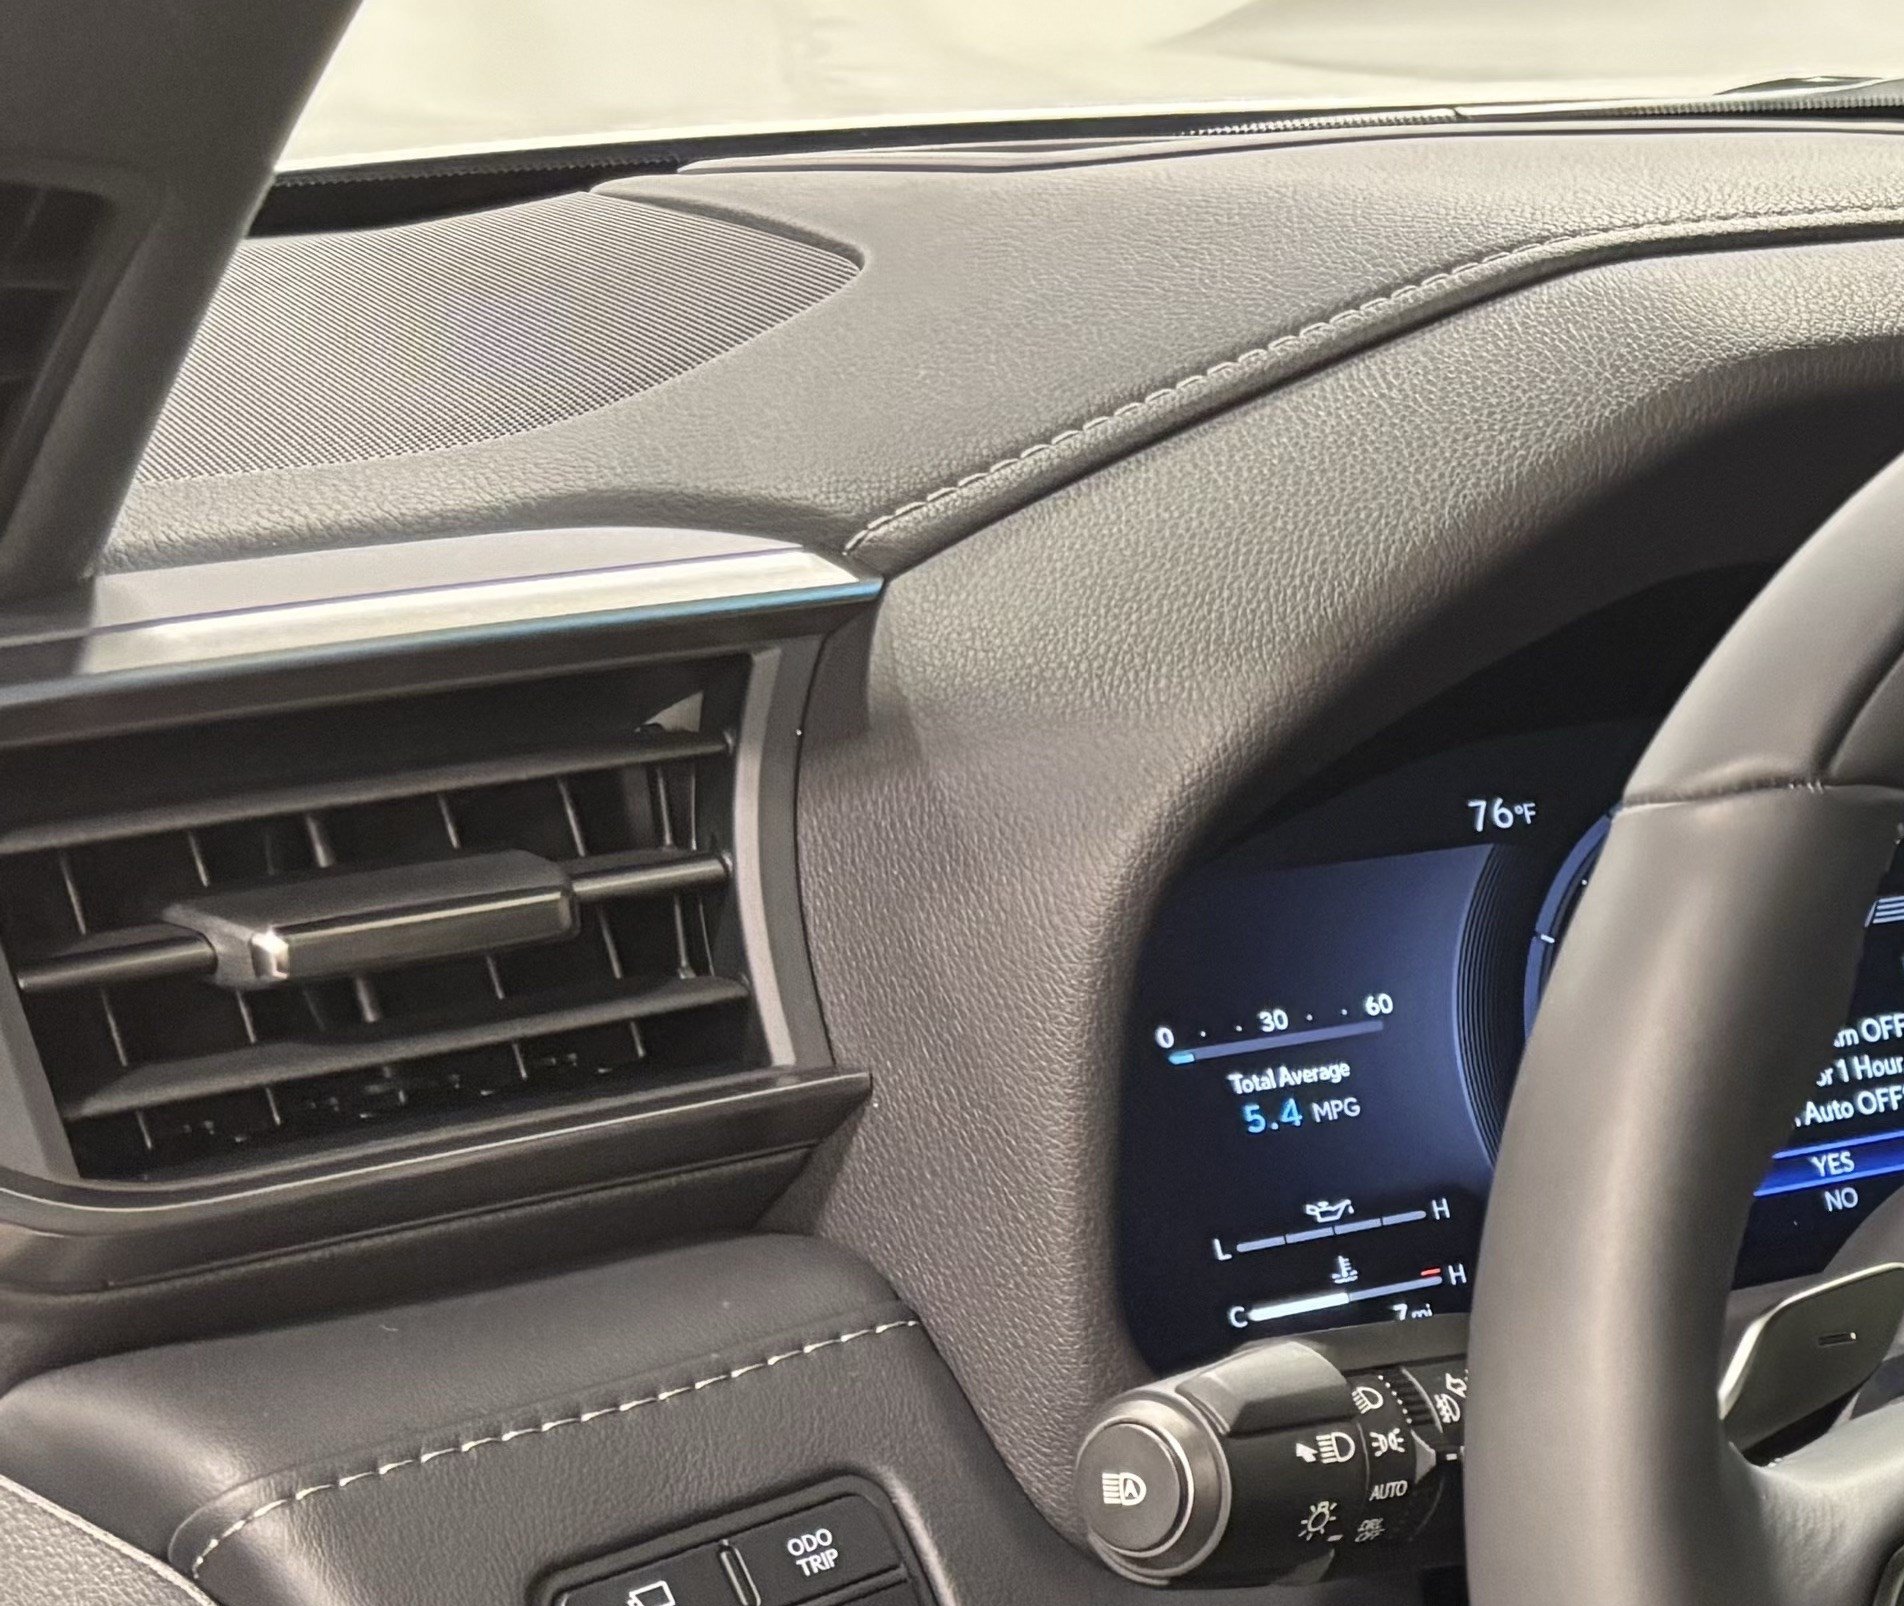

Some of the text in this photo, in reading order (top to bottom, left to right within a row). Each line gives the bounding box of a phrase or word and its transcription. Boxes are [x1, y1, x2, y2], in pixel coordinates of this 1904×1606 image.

[1364, 993, 1394, 1016] 60
[1259, 1008, 1290, 1034] 30
[1228, 1058, 1351, 1095] Total Average
[1242, 1096, 1362, 1135] 5.4 MPG
[1804, 1099, 1855, 1126] Auto
[1811, 1151, 1856, 1177] YES
[1431, 1199, 1450, 1221] H
[1824, 1187, 1859, 1212] NO
[1213, 1239, 1232, 1263] L
[1447, 1264, 1467, 1286] H
[1369, 1479, 1408, 1502] AUTO
[786, 1527, 834, 1558] ODO
[795, 1546, 840, 1578] TRIP
